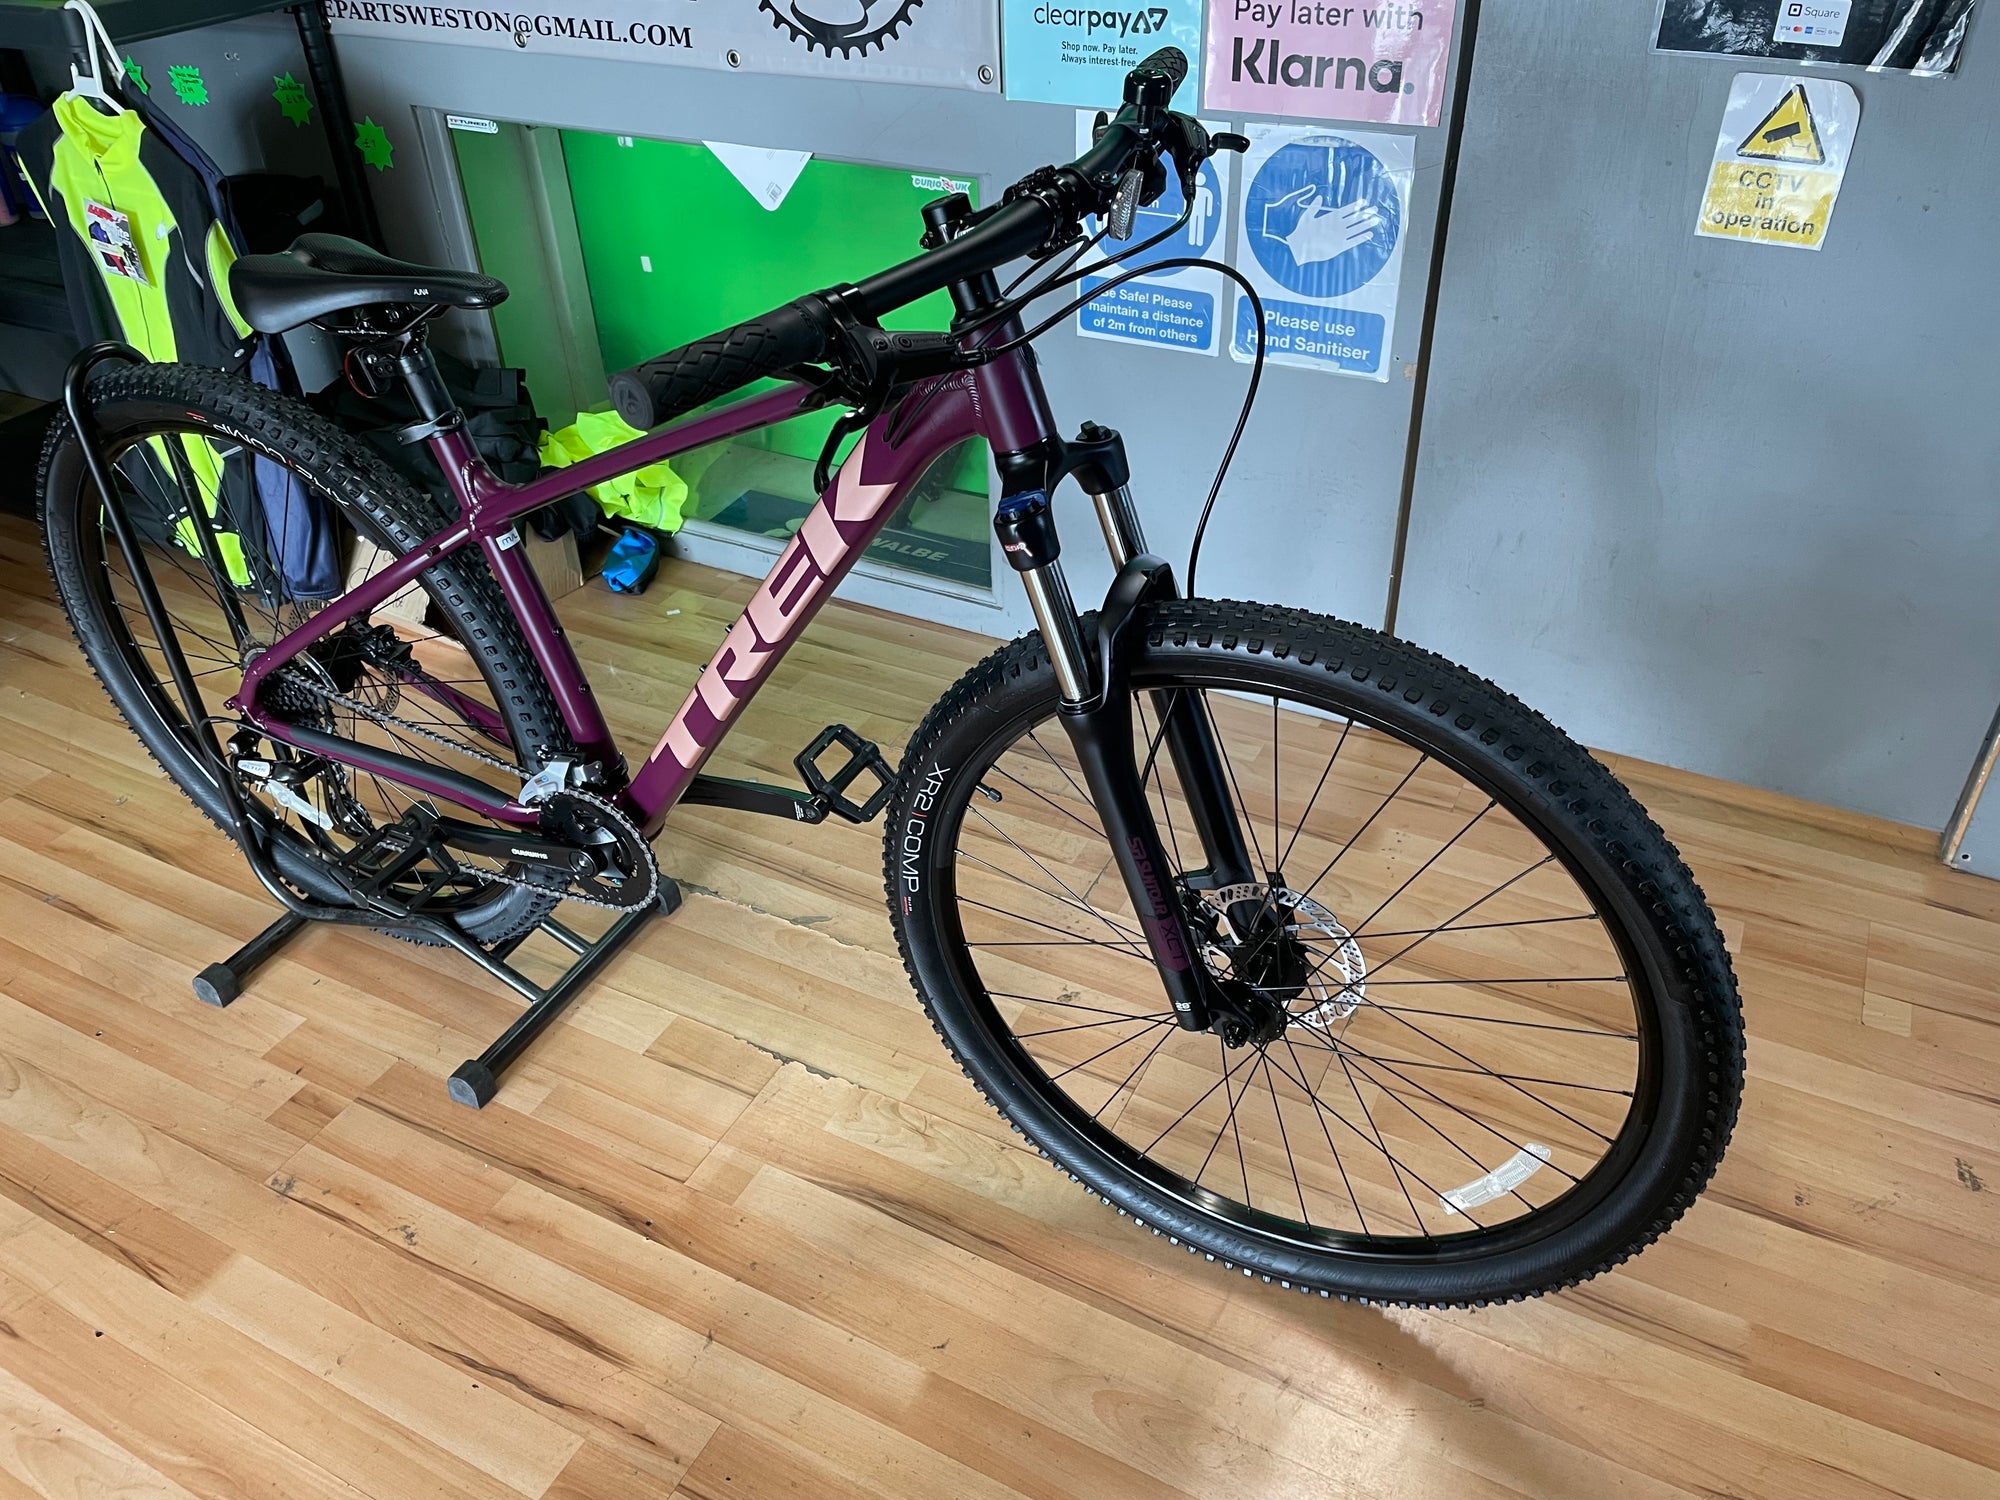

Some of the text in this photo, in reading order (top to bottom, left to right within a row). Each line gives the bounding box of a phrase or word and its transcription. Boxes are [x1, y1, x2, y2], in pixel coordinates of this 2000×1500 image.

[1034, 2, 1132, 38] clearpay
[1234, 0, 1423, 30] Pay later with
[1803, 6, 1840, 18] Square
[1061, 41, 1138, 55] Shop now. Pay later.
[1061, 53, 1087, 65] Always
[914, 178, 968, 191] CURIO UK
[1740, 170, 1804, 192] CCTV
[1755, 192, 1775, 209] in
[1712, 212, 1814, 235] operation
[1120, 289, 1149, 303] Safe!
[1153, 294, 1193, 310] Please
[1089, 301, 1203, 328] maintain a distance
[1264, 310, 1356, 337] Please use
[1094, 317, 1198, 343] of 2m from others
[1247, 329, 1370, 361] Hnd Sanitiser
[651, 424, 898, 769] TREK
[902, 762, 950, 892] XR2 COMP
